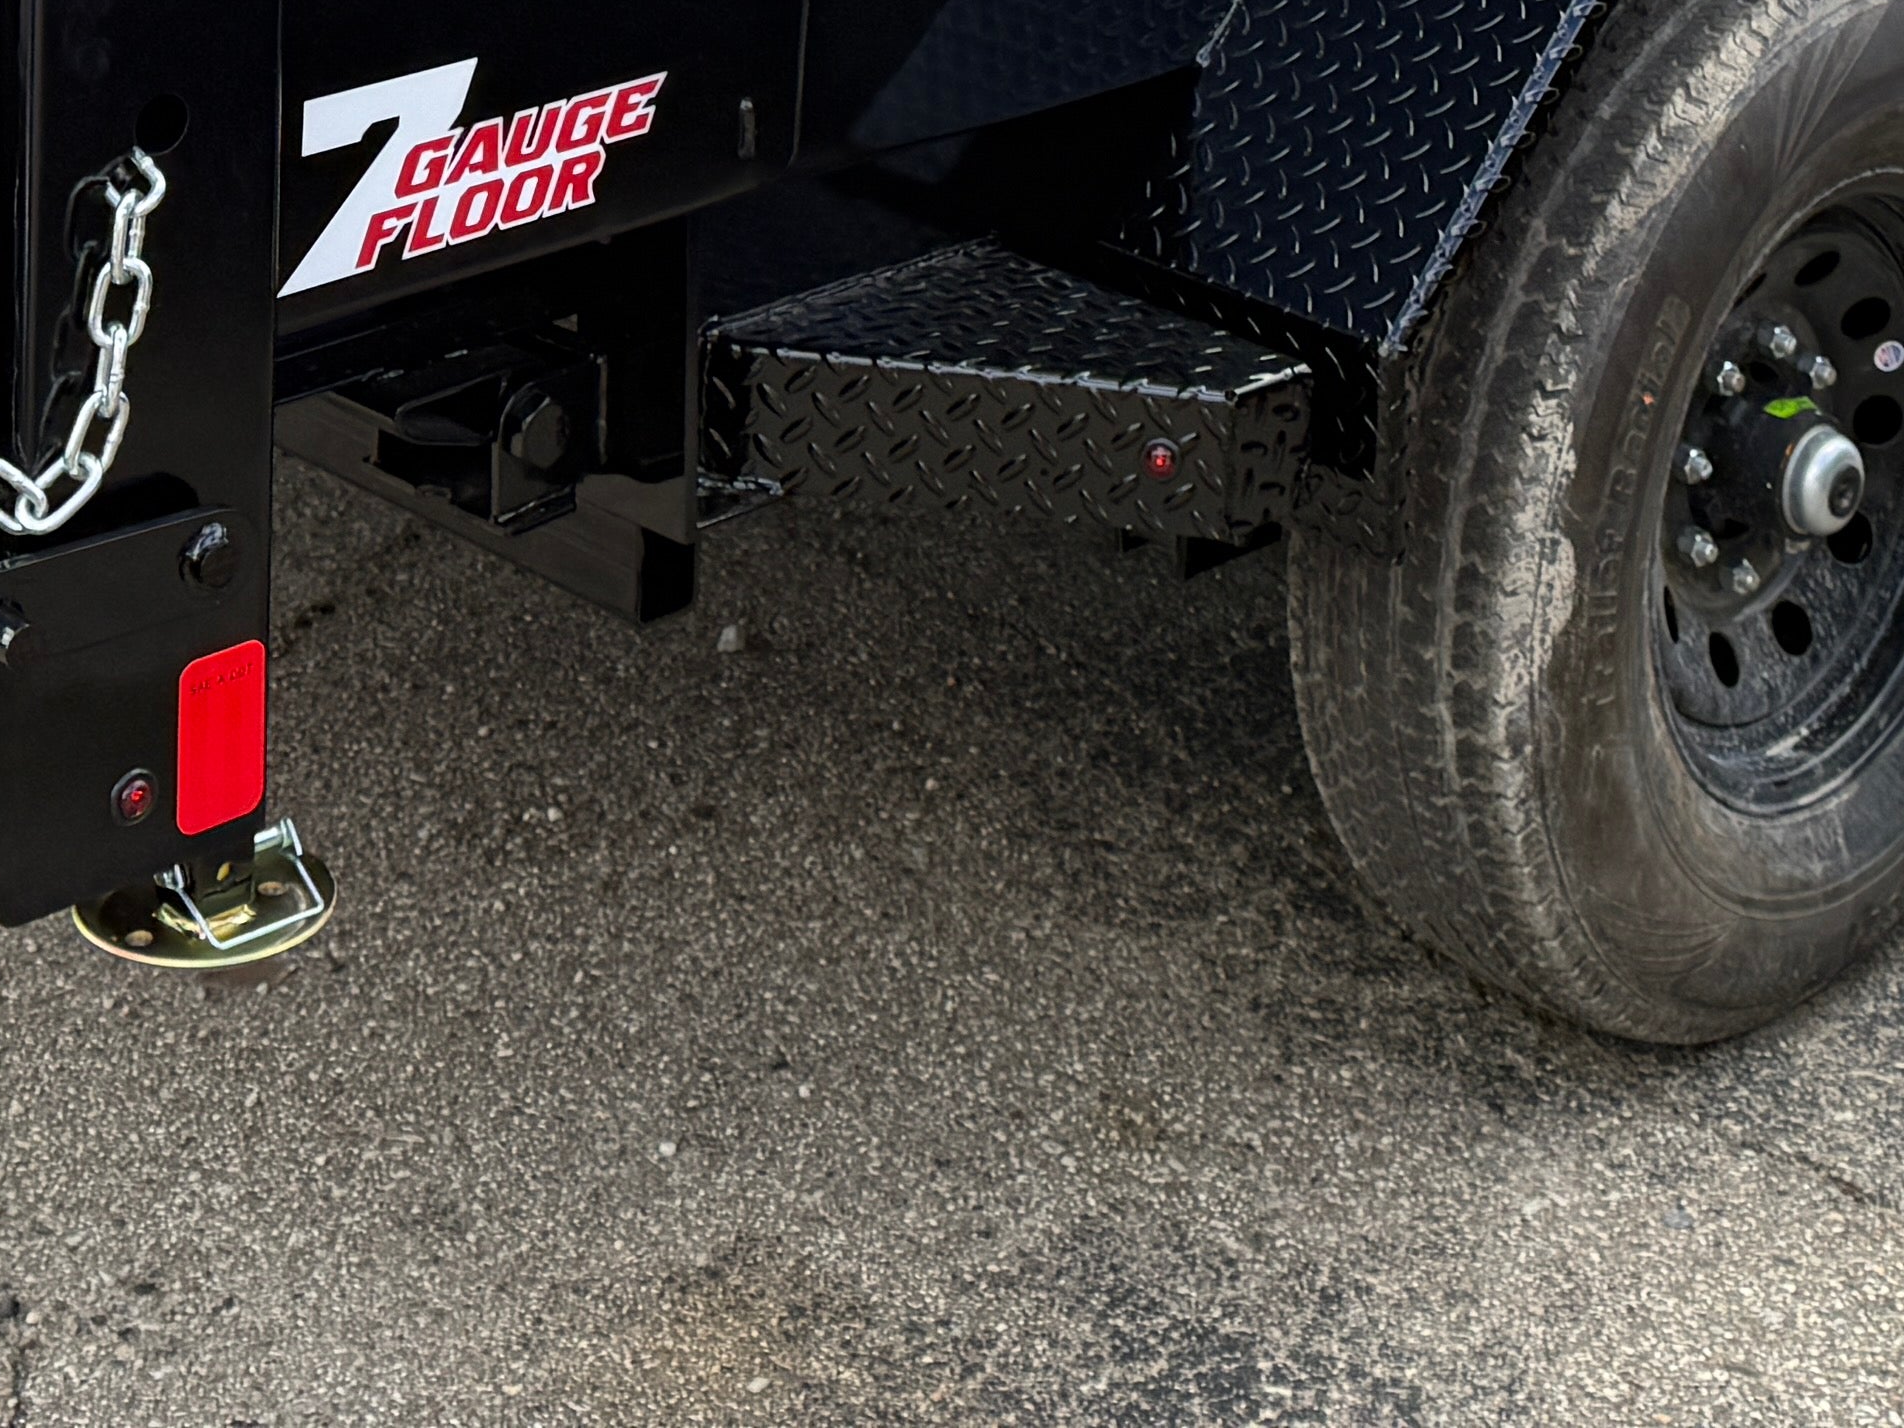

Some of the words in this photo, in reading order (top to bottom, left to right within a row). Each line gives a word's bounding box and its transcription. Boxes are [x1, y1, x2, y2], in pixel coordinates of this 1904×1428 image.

[277, 56, 479, 299] 7
[394, 70, 669, 200] GAUGE
[354, 147, 607, 270] FLOOR
